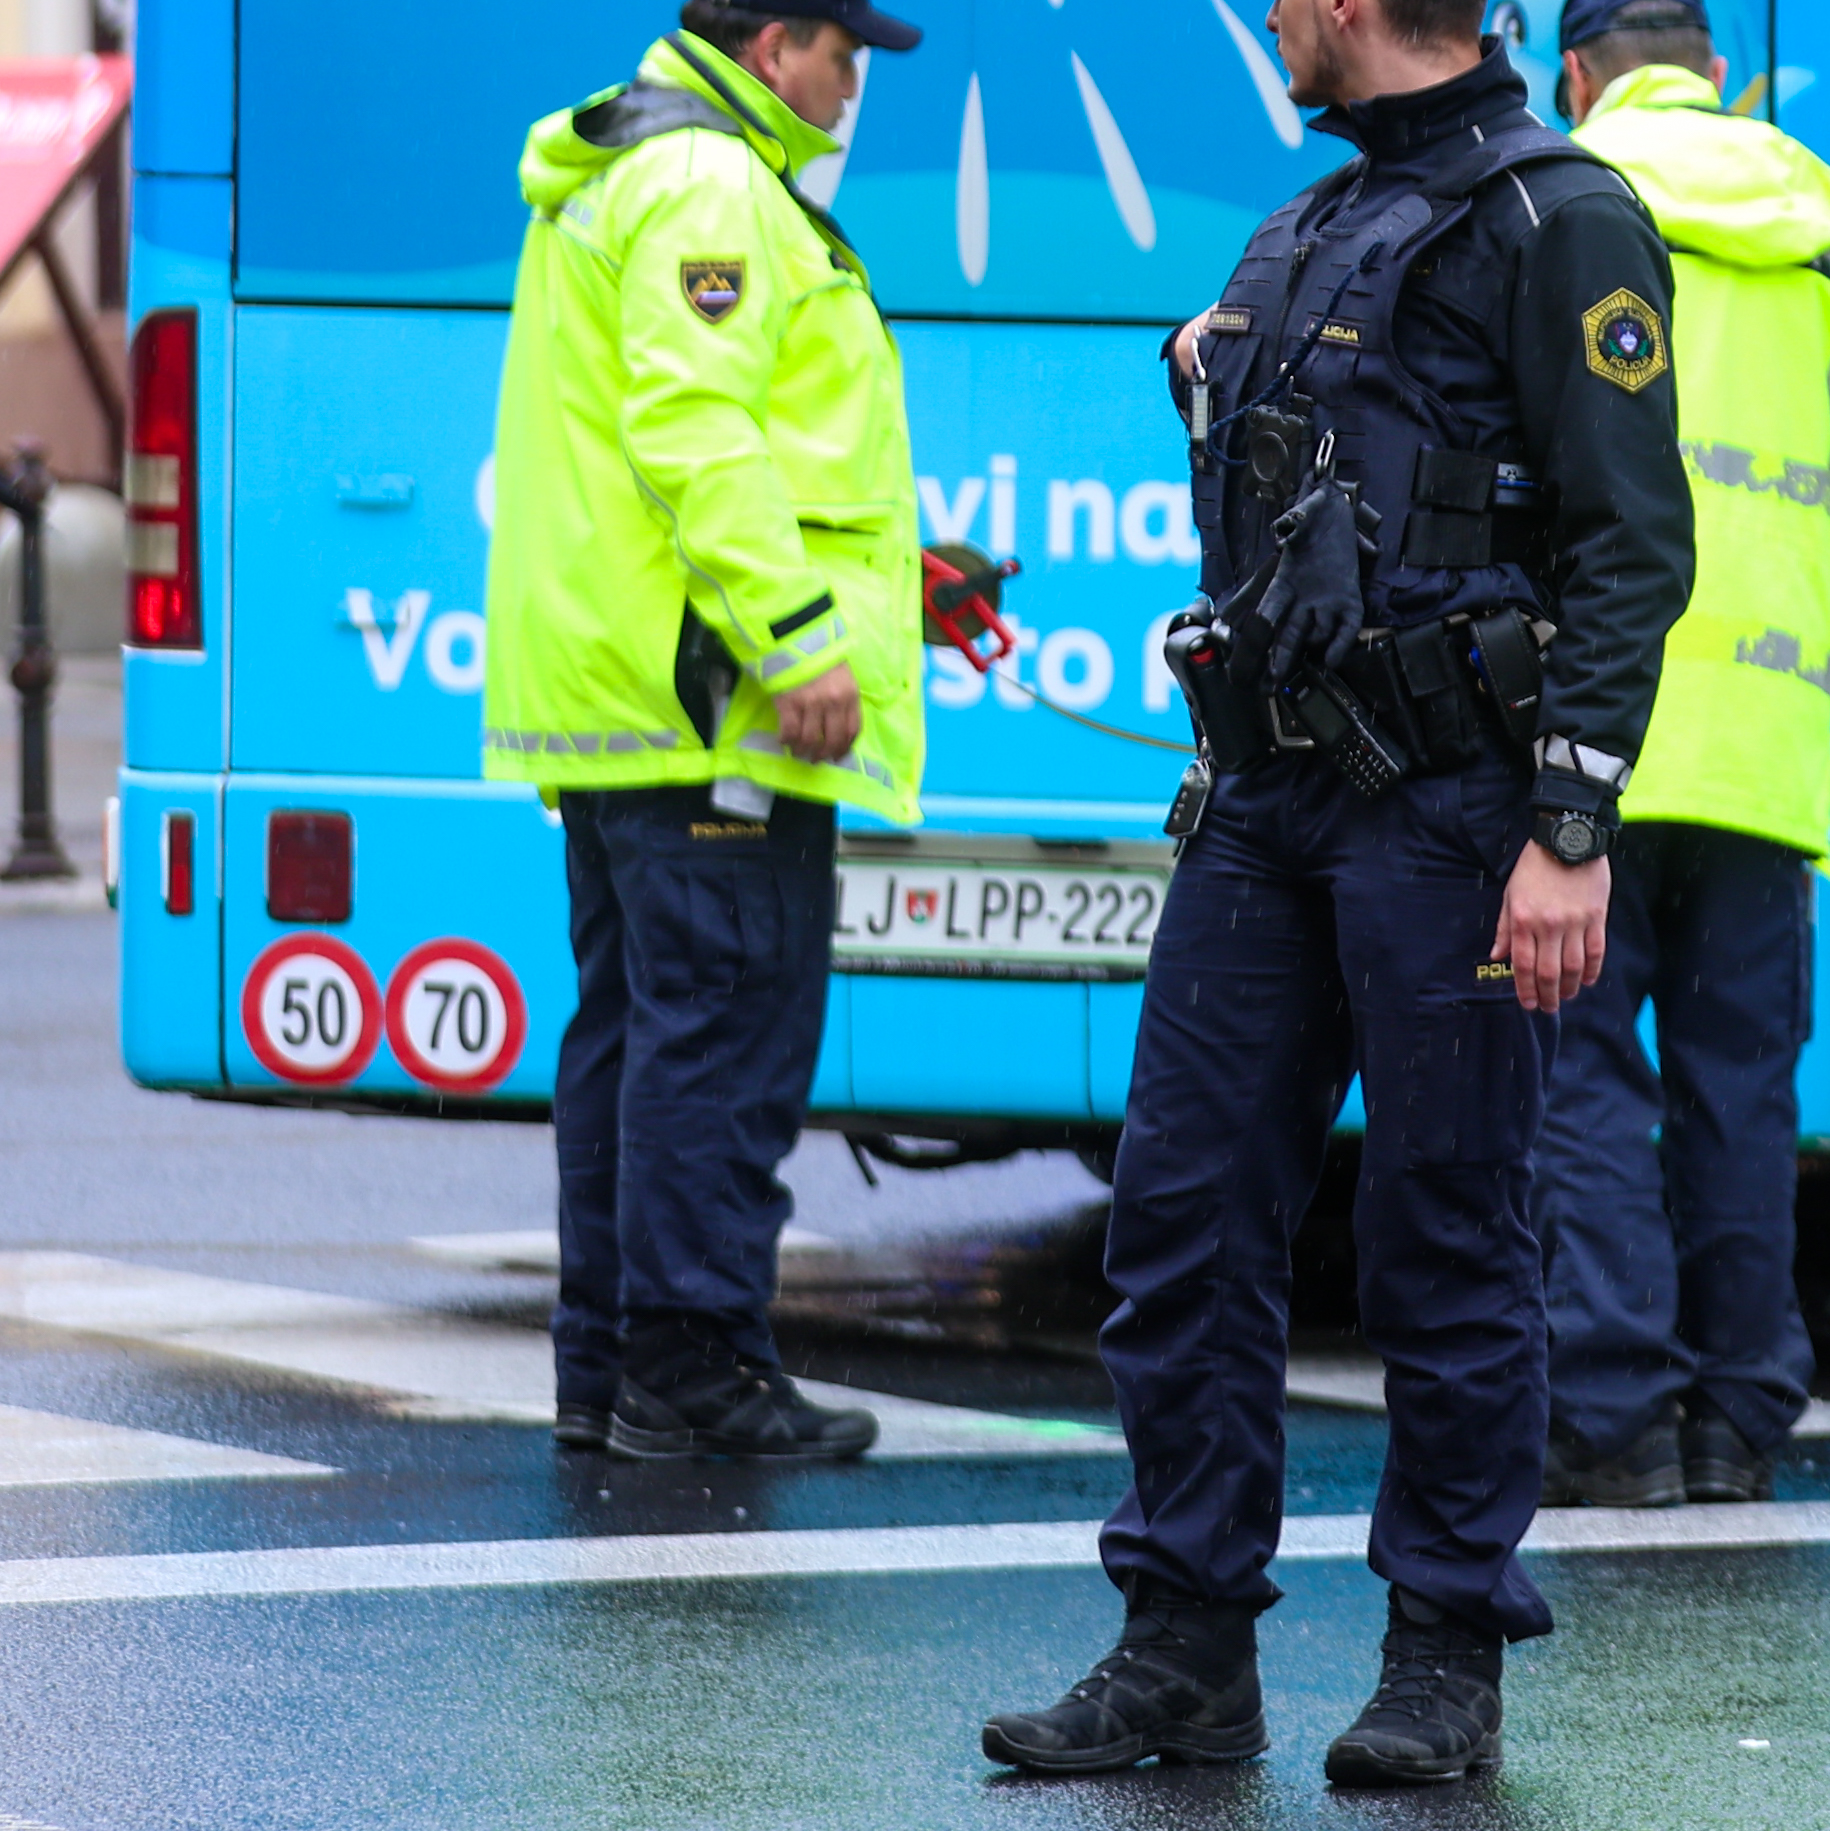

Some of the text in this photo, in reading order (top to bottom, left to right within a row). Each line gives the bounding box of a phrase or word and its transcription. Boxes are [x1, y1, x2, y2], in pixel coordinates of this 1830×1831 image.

[1608, 354, 1652, 370] POLICIJA
[834, 874, 1157, 944] LJ LPP-222
[281, 977, 347, 1038] 50
[423, 981, 488, 1043] 70
